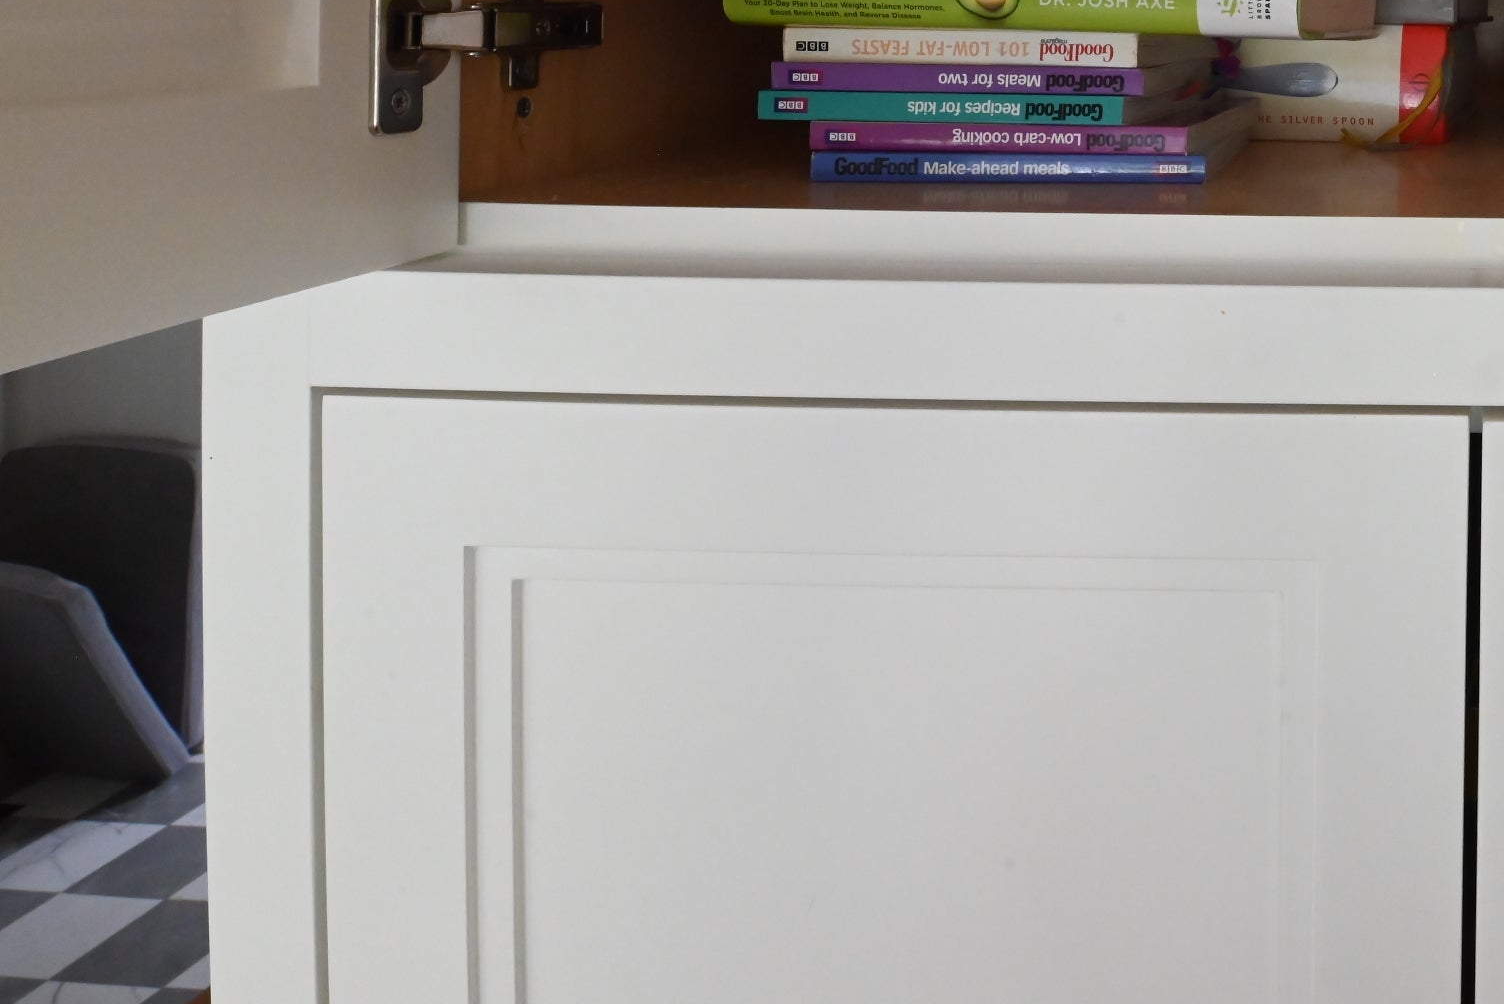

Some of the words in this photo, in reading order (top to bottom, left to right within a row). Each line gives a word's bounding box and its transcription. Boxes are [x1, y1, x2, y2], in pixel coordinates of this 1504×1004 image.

[763, 0, 790, 8] 30-Day
[792, 0, 808, 8] Plan
[820, 1, 838, 9] Lose
[840, 2, 870, 10] Weight,
[892, 12, 921, 20] Disease
[795, 41, 829, 52] BBC
[851, 39, 910, 55] FEASTS
[916, 40, 990, 57] LOW-FAT
[999, 42, 1030, 56] 101
[792, 73, 819, 82] BBC
[938, 73, 968, 85] two
[972, 73, 993, 87] for
[997, 74, 1041, 88] Meals
[1046, 74, 1125, 92] GoodFood
[778, 101, 804, 110] BBC
[907, 100, 936, 116] kids
[939, 101, 961, 116] for
[965, 101, 1021, 116] Recipes
[1025, 102, 1103, 121] GoodFood
[1281, 116, 1323, 124] SILVER
[1332, 116, 1374, 126] SPOON
[829, 132, 856, 142] BBC
[952, 128, 1010, 146] cooking
[1013, 132, 1082, 146] Low-carb
[834, 157, 919, 176] GoodFood
[924, 161, 1019, 175] Make-ahead
[1023, 161, 1070, 176] meals
[1159, 164, 1187, 174] BBC
